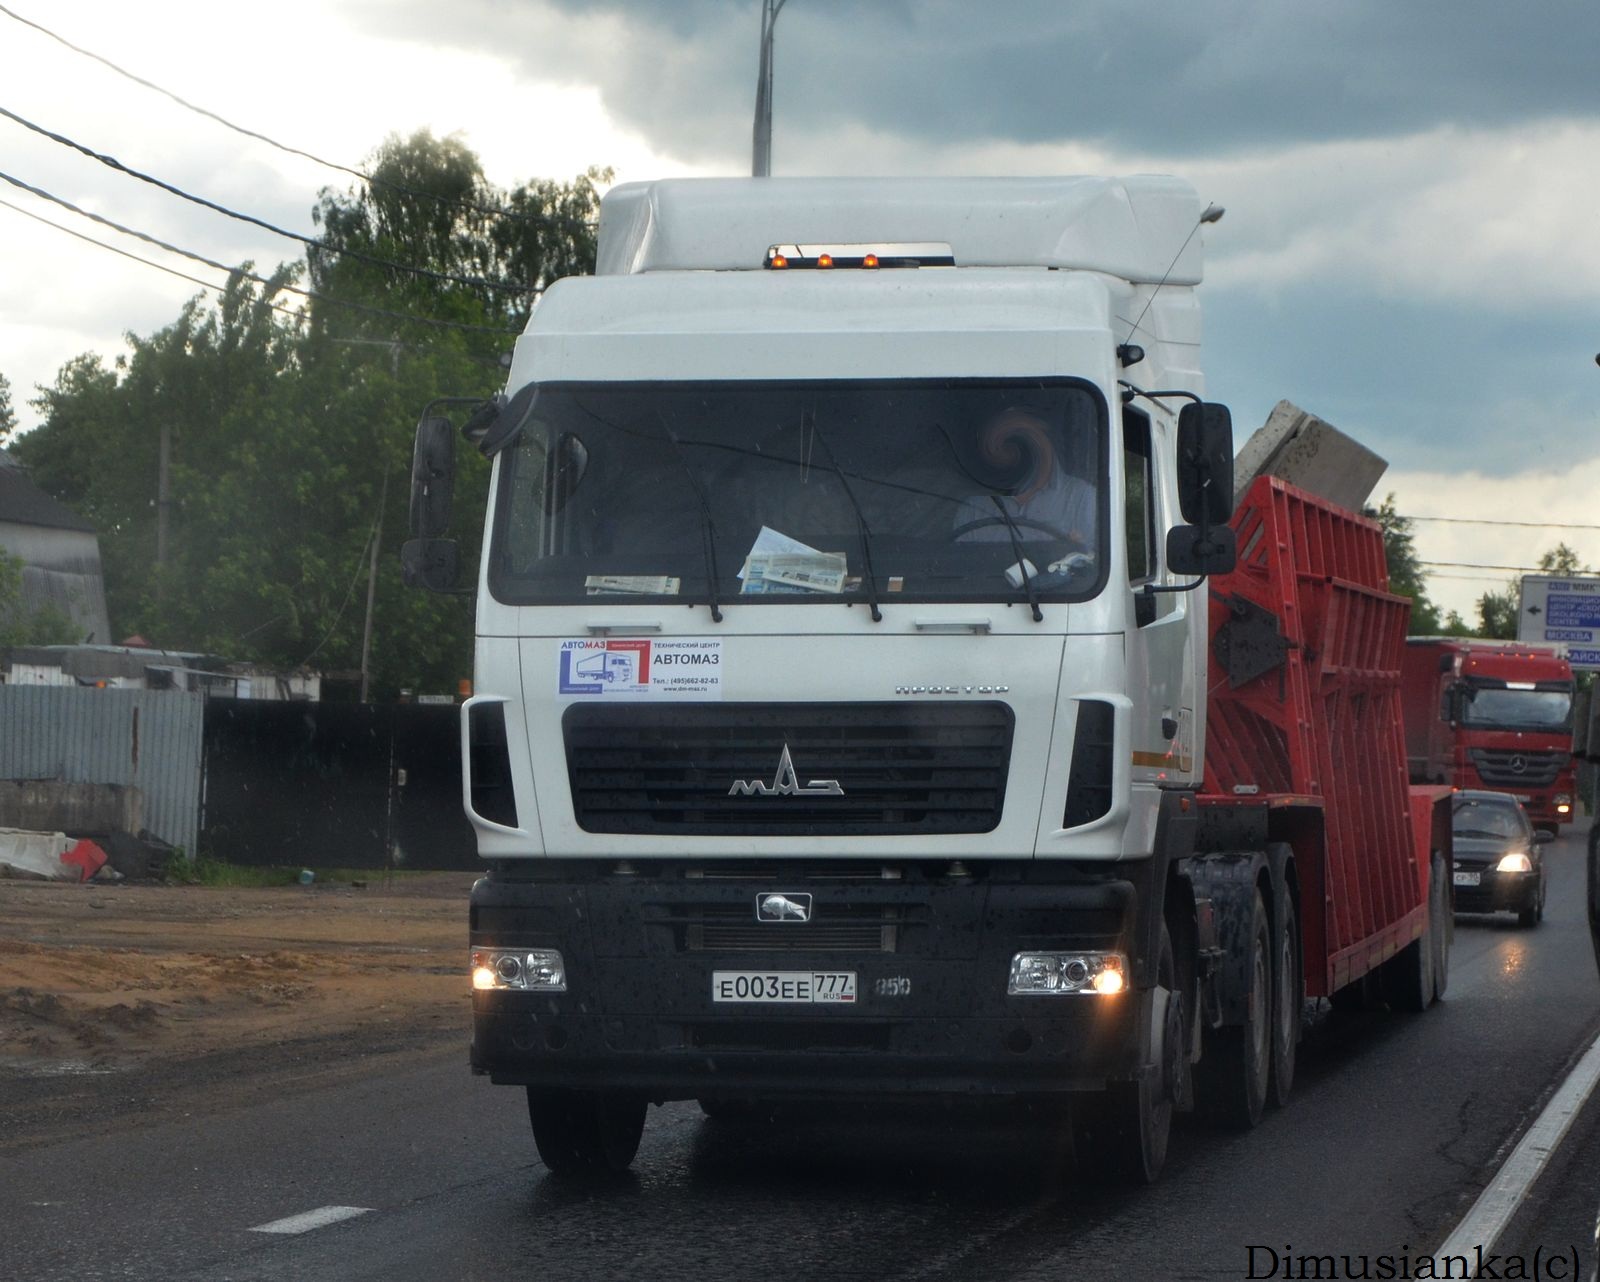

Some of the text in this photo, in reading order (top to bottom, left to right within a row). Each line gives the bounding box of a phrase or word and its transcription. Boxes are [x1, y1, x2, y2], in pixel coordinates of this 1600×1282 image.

[561, 641, 606, 649] АВТОМАЗ
[654, 654, 719, 665] АВТОМАЗ
[720, 975, 849, 999] Е003ЕЕ 777
